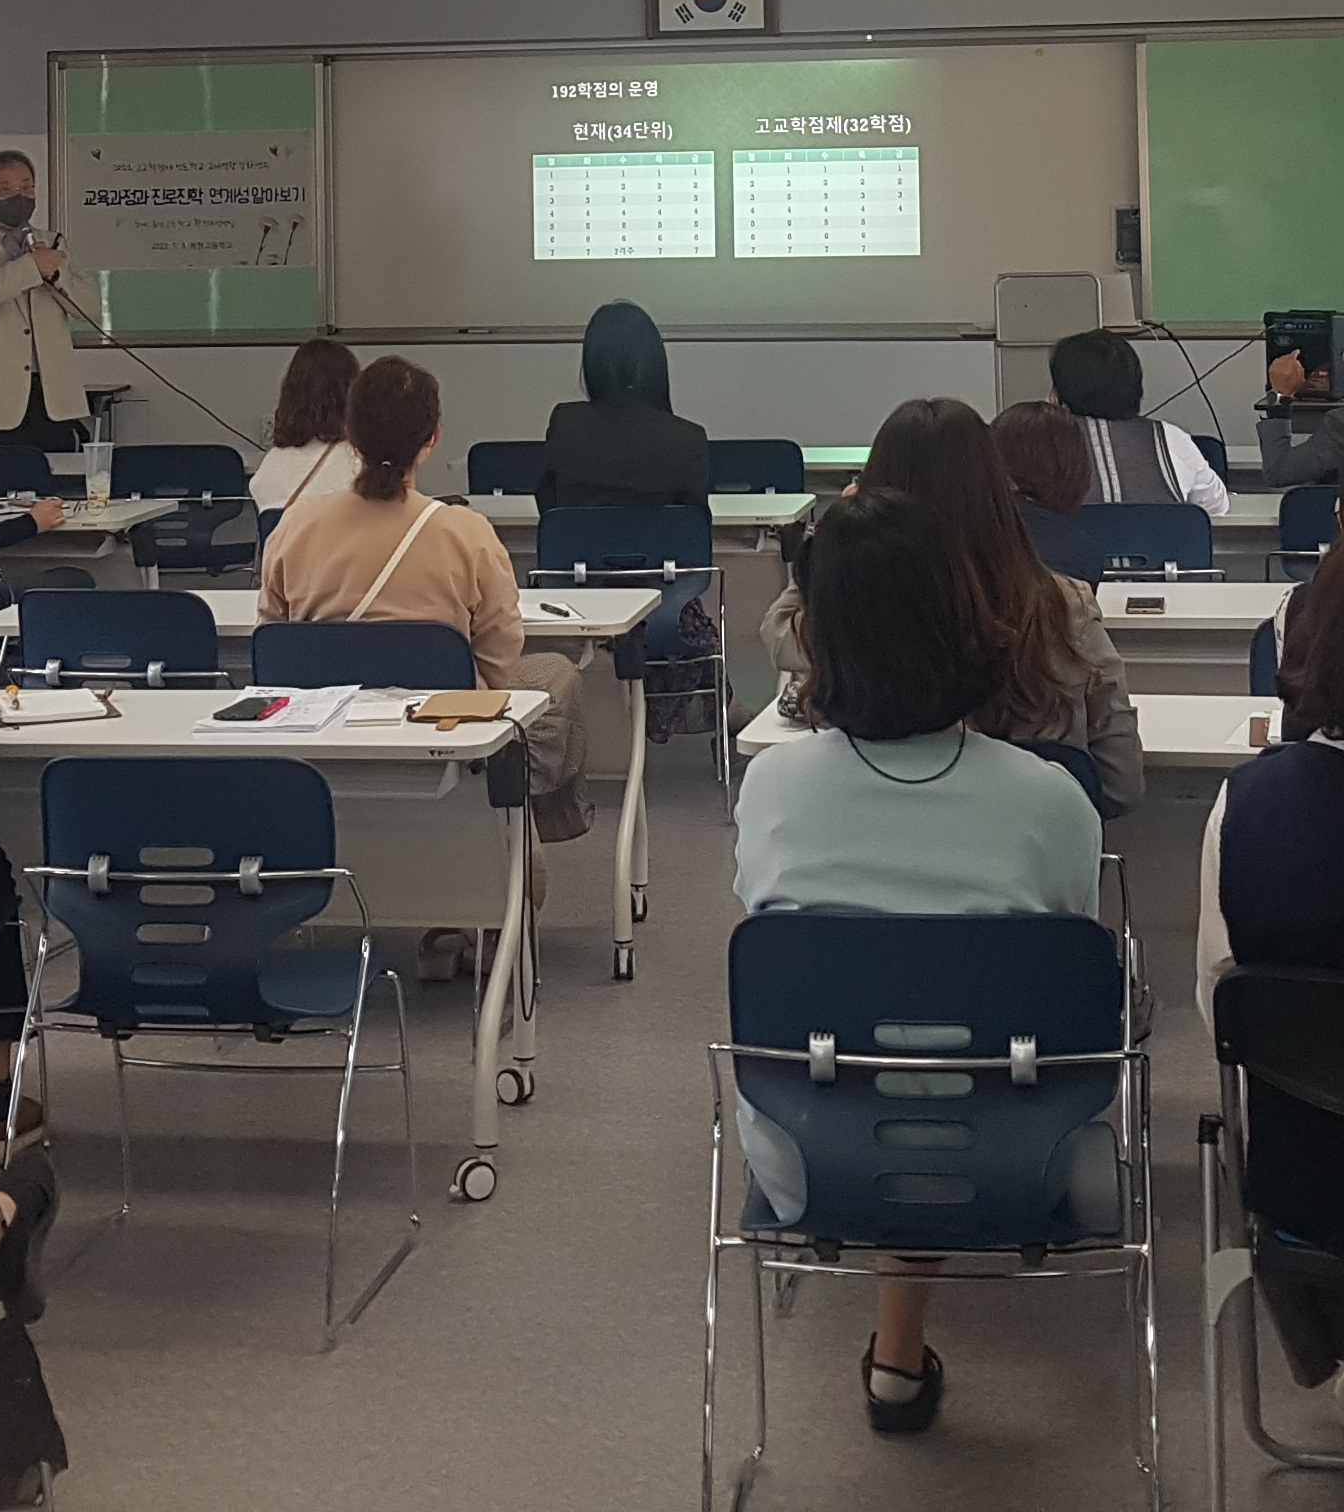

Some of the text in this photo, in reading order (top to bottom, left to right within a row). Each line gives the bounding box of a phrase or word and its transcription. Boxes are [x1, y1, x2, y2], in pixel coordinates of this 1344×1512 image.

[551, 80, 659, 99] 192학점의 운영
[572, 121, 674, 141] 현재(34단위)
[754, 114, 912, 136] 고교학점제(32학점)
[83, 186, 306, 207] 교육과정과 진로진학 연계성 알아보기
